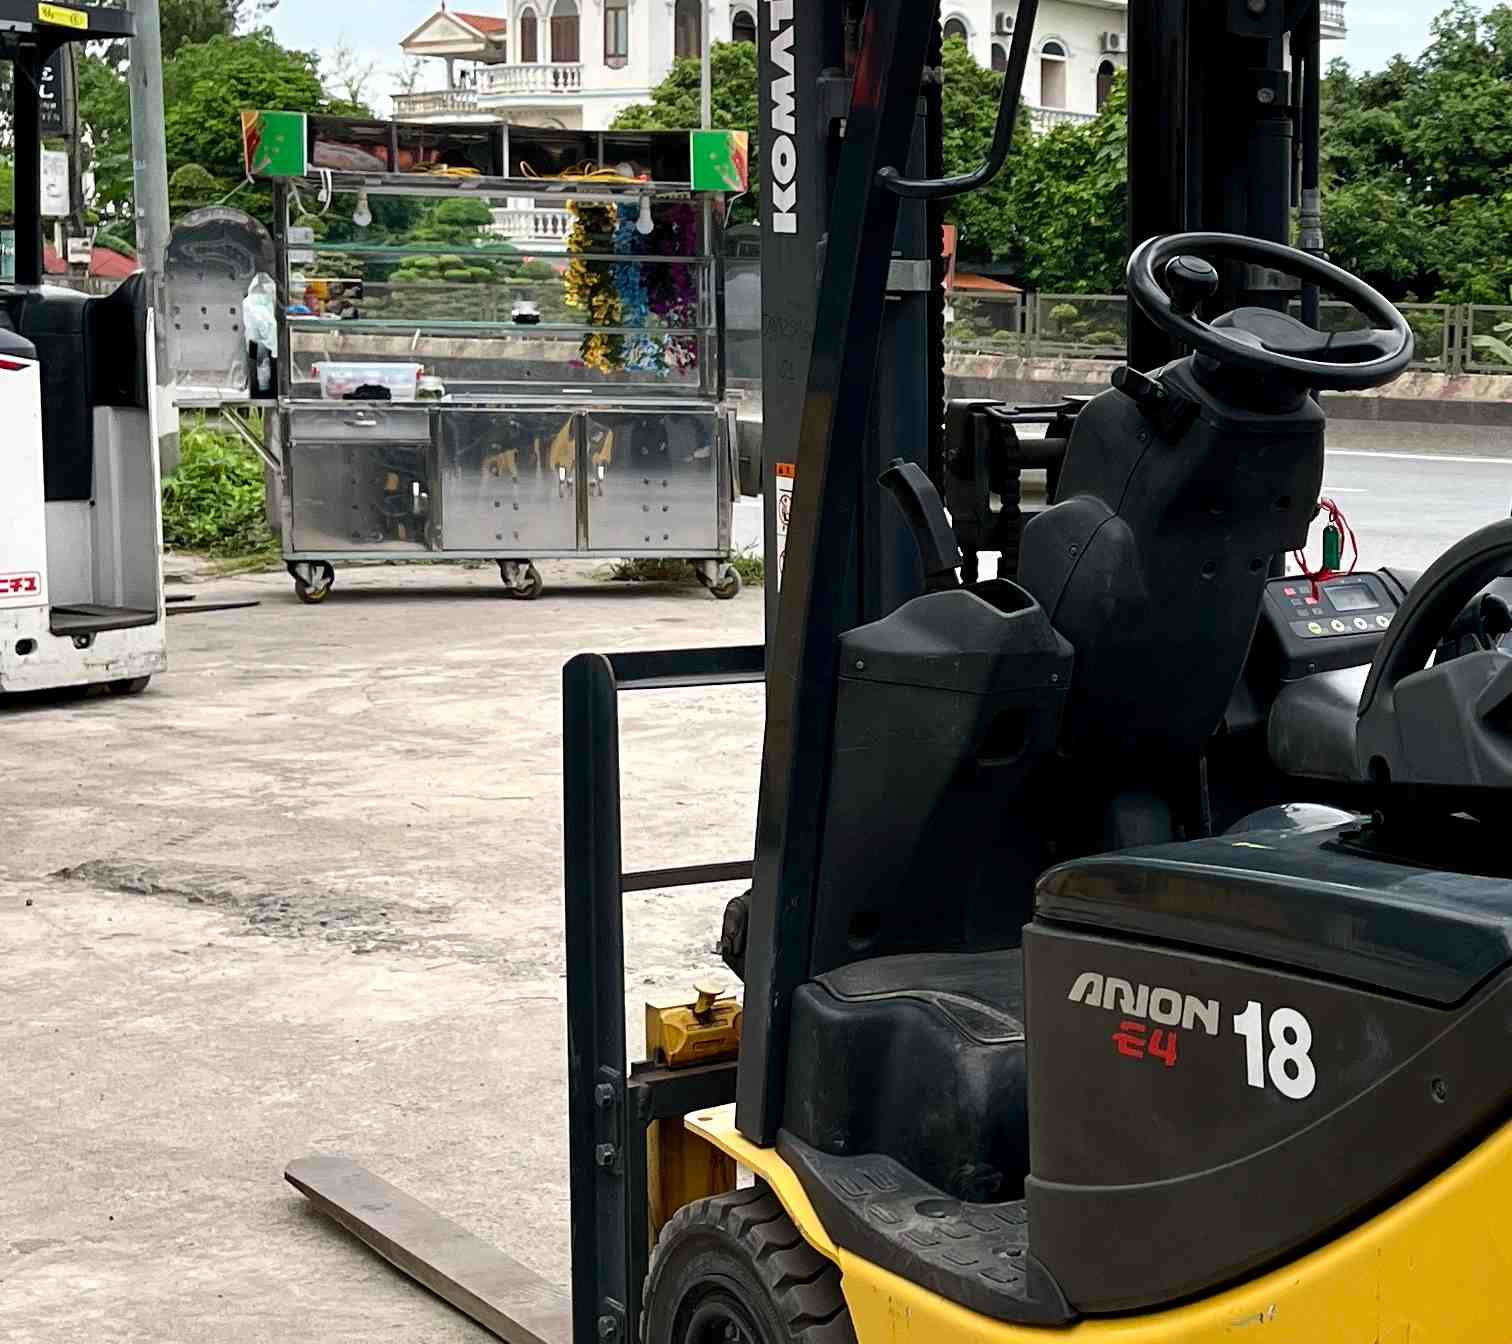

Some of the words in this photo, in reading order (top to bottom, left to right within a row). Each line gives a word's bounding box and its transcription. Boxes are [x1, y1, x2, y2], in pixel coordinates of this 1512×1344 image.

[1067, 972, 1220, 1036] ARION
[1233, 1000, 1317, 1100] 18
[1111, 1020, 1178, 1068] E4
